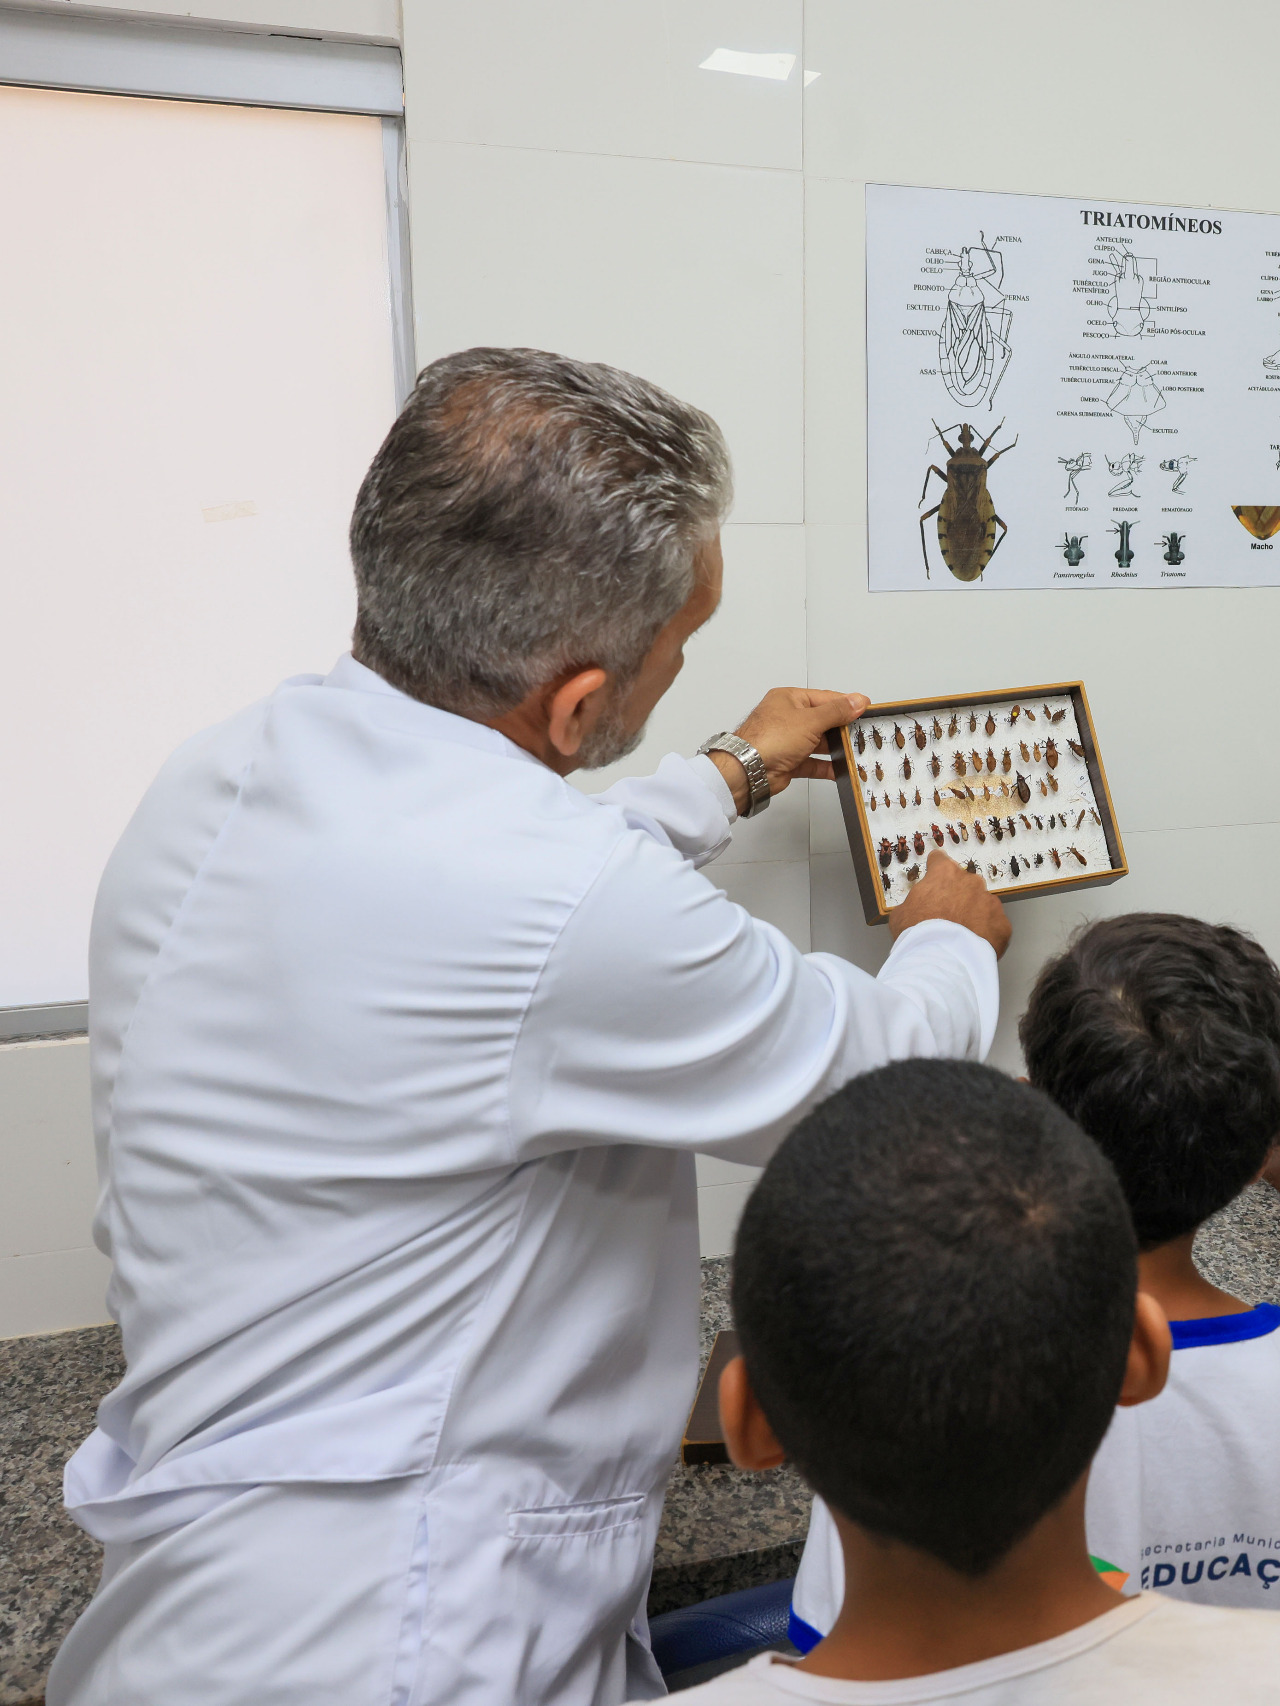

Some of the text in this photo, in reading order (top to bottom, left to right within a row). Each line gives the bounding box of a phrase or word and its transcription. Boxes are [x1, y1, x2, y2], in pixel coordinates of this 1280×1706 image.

[1080, 211, 1222, 234] TRIATOMÍNEOS
[926, 248, 952, 256] CABEÇA
[1170, 328, 1206, 336] PÓS-OCULAR
